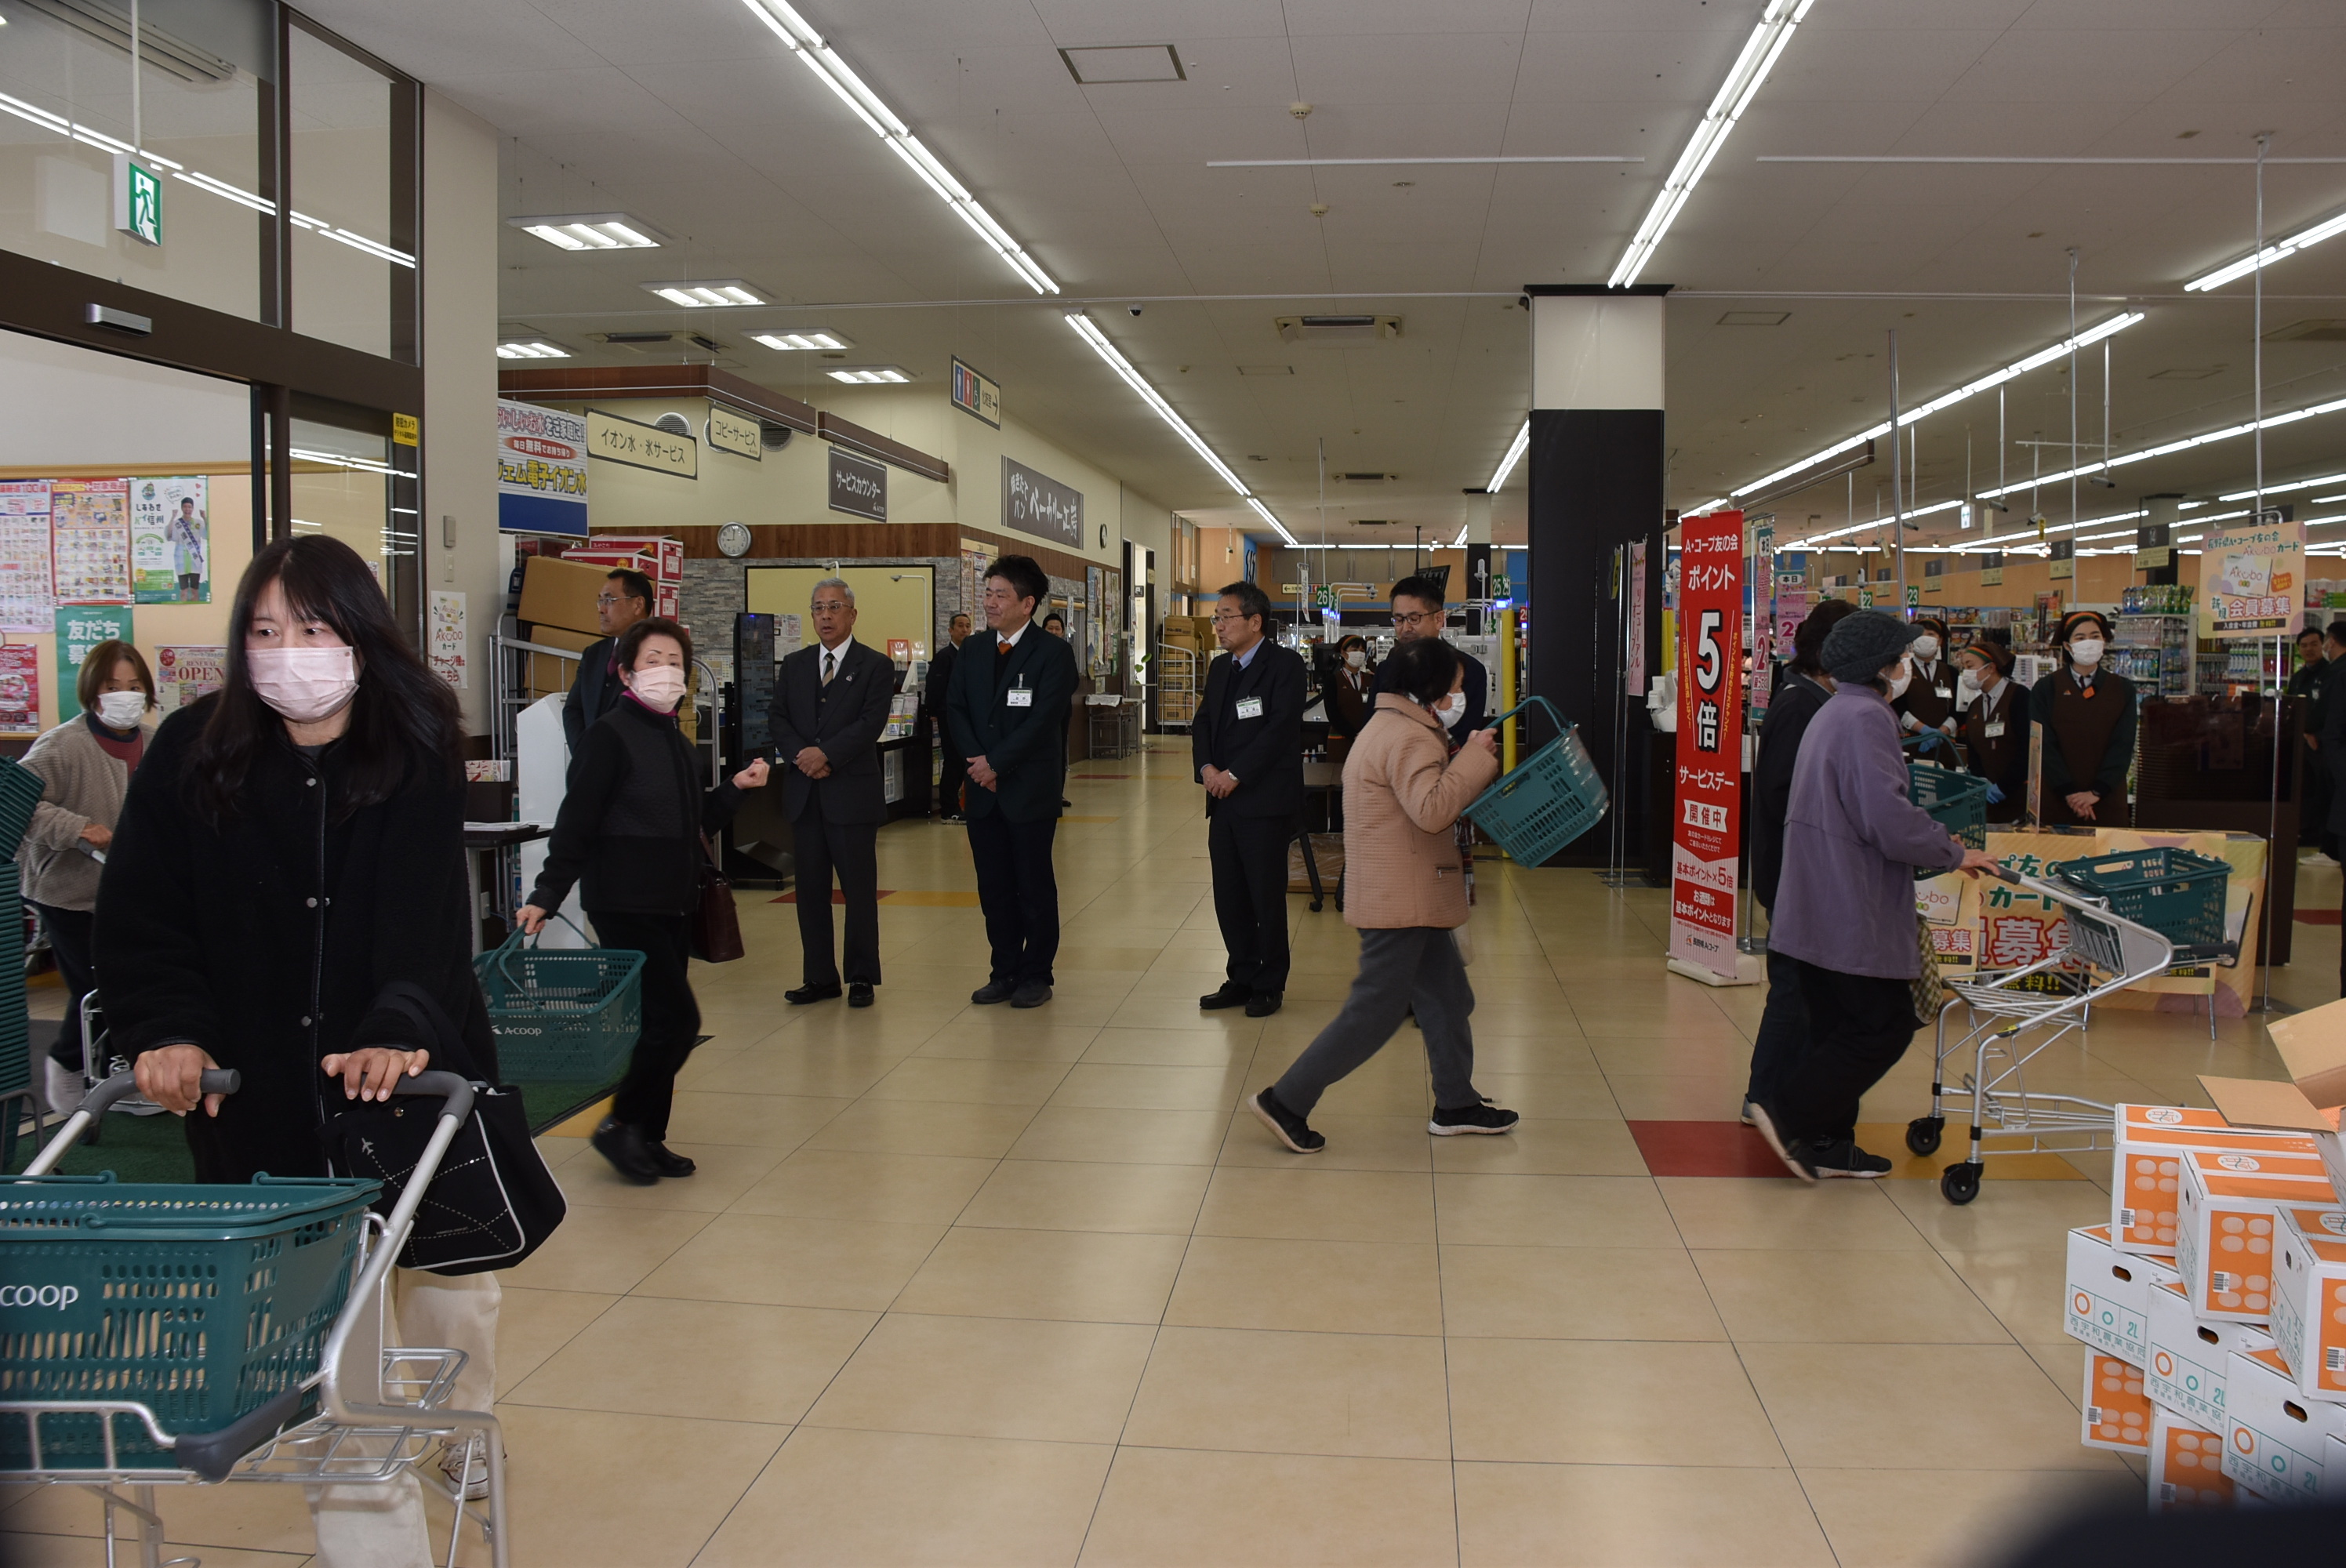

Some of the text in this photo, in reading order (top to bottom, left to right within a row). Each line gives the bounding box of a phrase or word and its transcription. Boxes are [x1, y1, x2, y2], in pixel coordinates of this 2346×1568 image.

[715, 420, 757, 448] コピーサービス
[601, 428, 685, 464] イオン水・氷サービス
[836, 469, 881, 499] サービスカウンター
[1014, 499, 1026, 520] パン
[1030, 486, 1077, 540] ベーカリー工房
[2277, 541, 2300, 553] カード
[1492, 578, 1502, 596] 25
[1688, 564, 1735, 591] ポイント
[1317, 590, 1327, 605] 26
[1908, 589, 1918, 605] 23
[2229, 596, 2291, 619] 会員募集
[67, 619, 120, 641] 友だち
[67, 644, 95, 665] 募
[442, 642, 456, 651] カード
[434, 655, 465, 666] チャージ機は
[179, 667, 224, 681] OPEN
[1680, 765, 1734, 791] サービスデー
[1690, 804, 1721, 828] 開催中
[1676, 900, 1731, 928] 基本ポイントとなります
[2126, 1321, 2138, 1339] 2L
[2213, 1387, 2225, 1407] 2L
